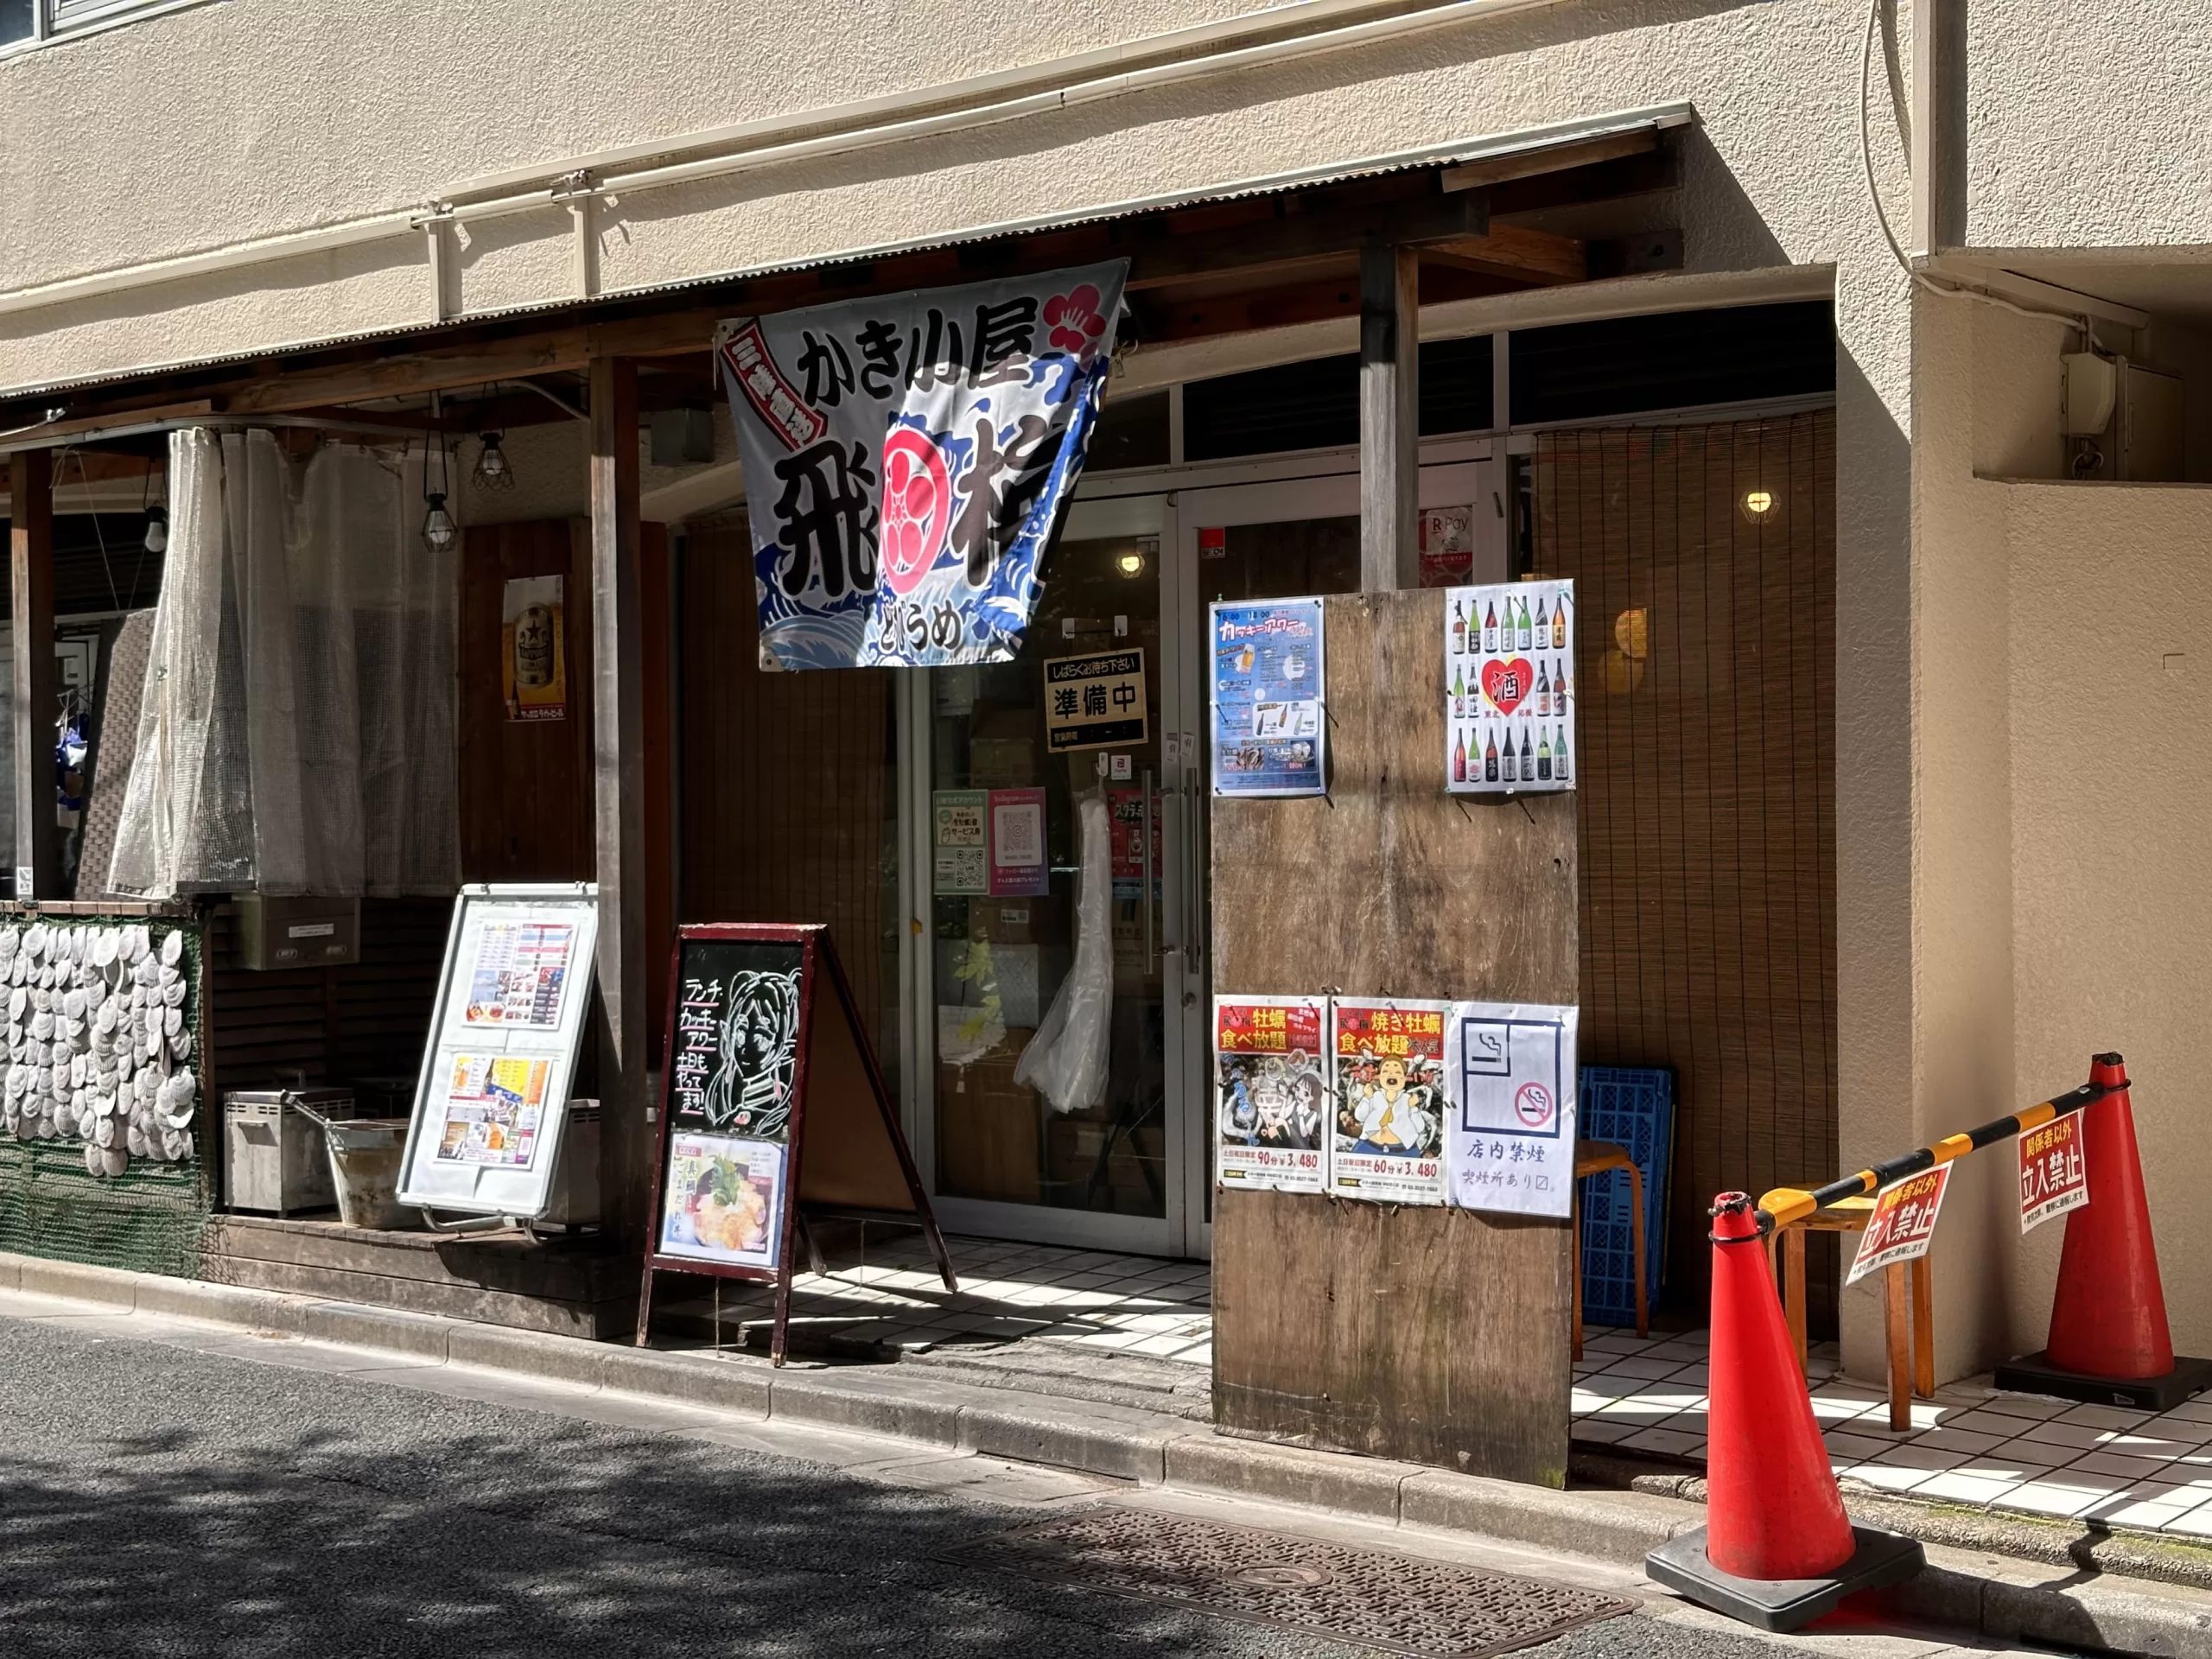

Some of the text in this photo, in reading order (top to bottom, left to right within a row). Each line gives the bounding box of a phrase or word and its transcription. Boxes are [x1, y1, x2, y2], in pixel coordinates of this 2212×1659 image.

[796, 296, 1039, 408] かき小屋
[1445, 517, 1468, 531] Pay
[1219, 617, 1300, 642] カッキーアワー
[1052, 657, 1135, 679] しばらくお待ち下さい
[1491, 671, 1520, 703] 酒
[1054, 681, 1136, 720] 準備中
[680, 1007, 717, 1027] カッキー
[1252, 1007, 1287, 1029] 牡蠣
[1371, 1011, 1441, 1034] 焼き牡蠣
[687, 1032, 718, 1047] アワー
[1220, 1028, 1287, 1050] 食べ放題
[1339, 1032, 1409, 1055] 食べ放題
[677, 1052, 708, 1070] 土日も
[677, 1071, 702, 1089] やって
[2025, 1118, 2073, 1159] 関係者以外
[1258, 1151, 1278, 1166] 90分
[1466, 1138, 1546, 1163] 店内禁煙
[1373, 1160, 1395, 1174] 60分
[2022, 1143, 2082, 1207] 立入禁止
[1881, 1173, 1939, 1213] 関係者以外
[1859, 1197, 1936, 1258] 立入禁止
